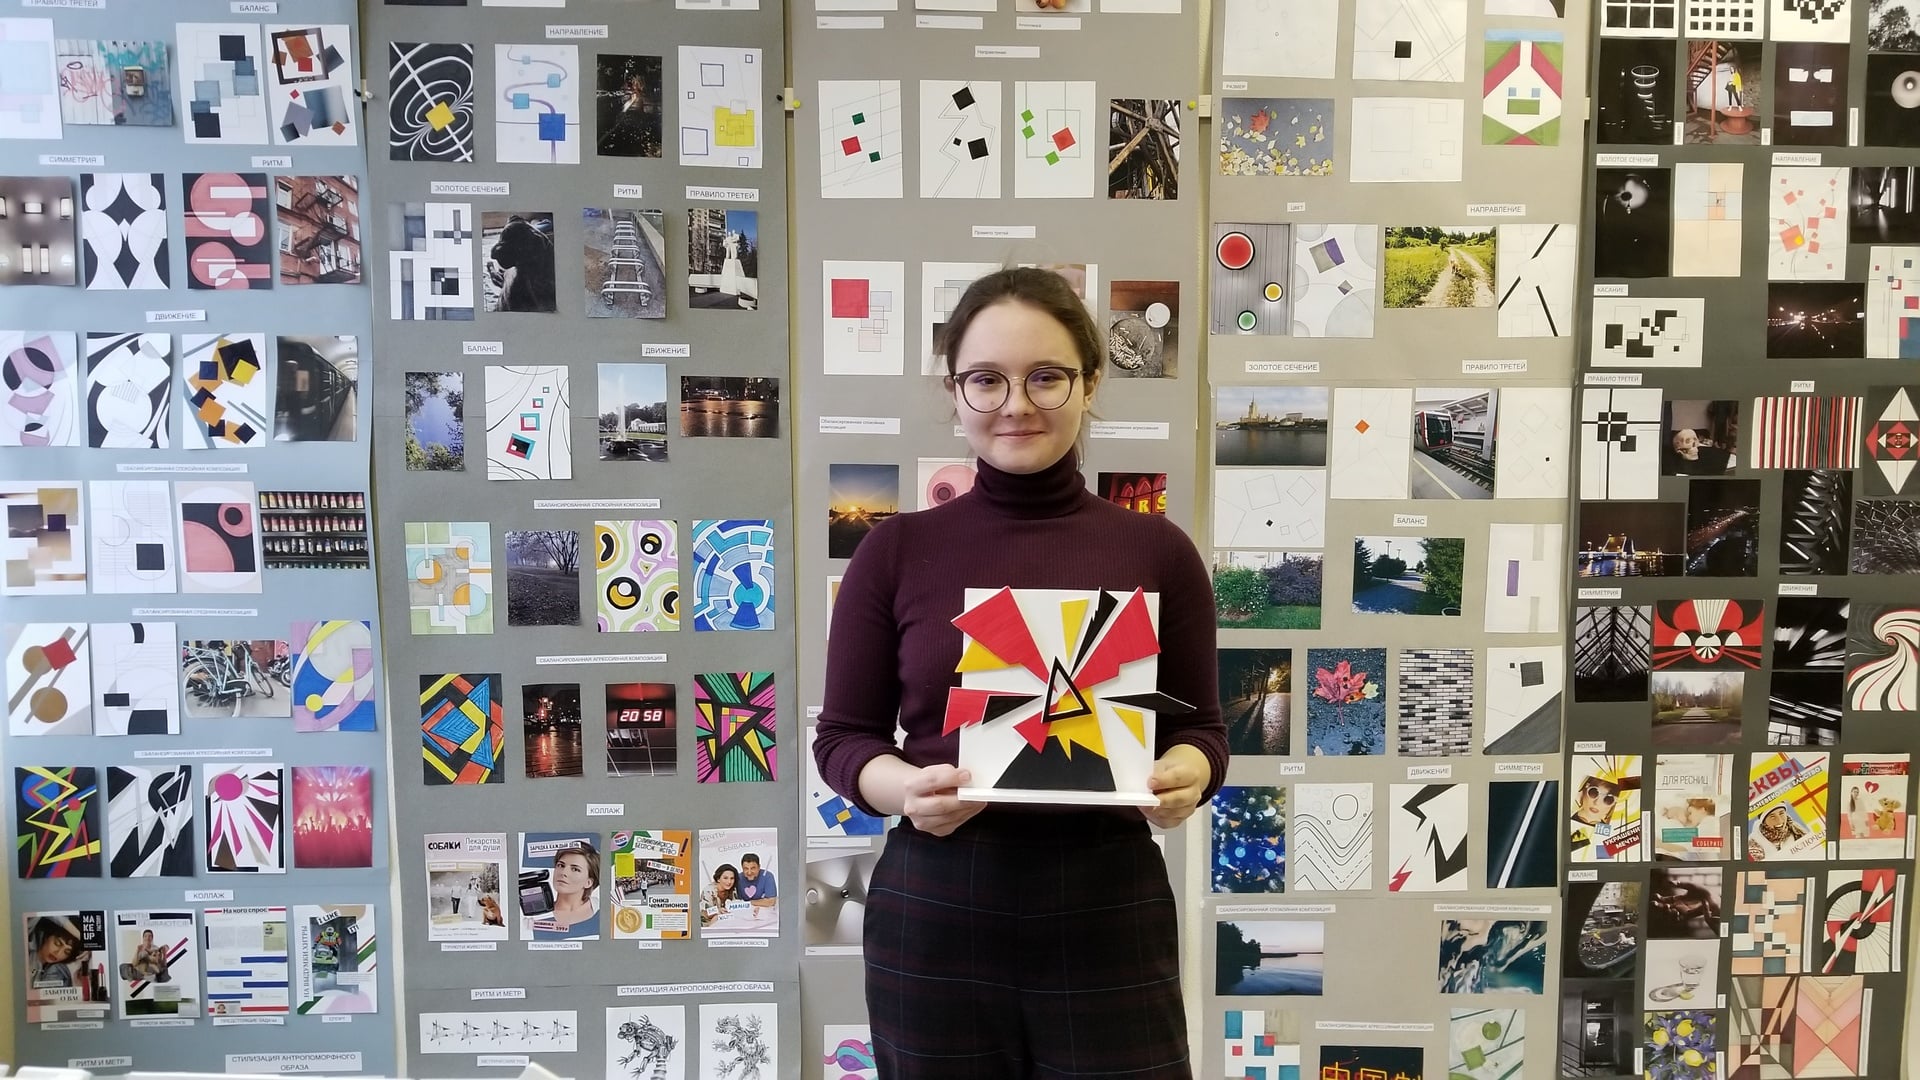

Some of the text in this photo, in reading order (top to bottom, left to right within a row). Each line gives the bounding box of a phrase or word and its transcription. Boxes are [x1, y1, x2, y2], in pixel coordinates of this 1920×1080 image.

[549, 28, 604, 36] НАПРАВЛЕНИЕ
[1775, 155, 1817, 163] НАПРАВЛЕНИЕ
[617, 188, 638, 196] РИТМ
[690, 190, 755, 200] ПРАВИЛО ТРЕТЕЙ
[155, 312, 197, 321] ДВИЖЕНИЕ
[645, 347, 687, 355] ДВИЖЕНИЕ
[1500, 362, 1526, 370] ТРЕТЕЙ
[1397, 517, 1425, 525] БАЛАНС
[620, 710, 663, 722] 20 58
[1410, 767, 1449, 776] ДВИЖЕНИЕ
[1662, 775, 1709, 786] ДЛЯ РЕСНИЦ
[428, 841, 461, 850] СОБАКИ
[465, 837, 501, 846] Лекарства
[1616, 835, 1640, 849] МЕЧТЫ
[194, 892, 225, 900] КОЛЛАЖ
[82, 915, 95, 924] MA
[322, 911, 338, 922] LIKE
[83, 924, 94, 932] KE
[83, 933, 95, 941] UP
[621, 983, 771, 994] СТИЛИЗАЦИЯ АНТРОПОМОРФНОГО ОБРАЗА
[105, 1058, 124, 1066] МЕТР
[232, 1053, 356, 1063] СТИЛИЗАЦИЯ АНТРОПОМОРФНОГО
